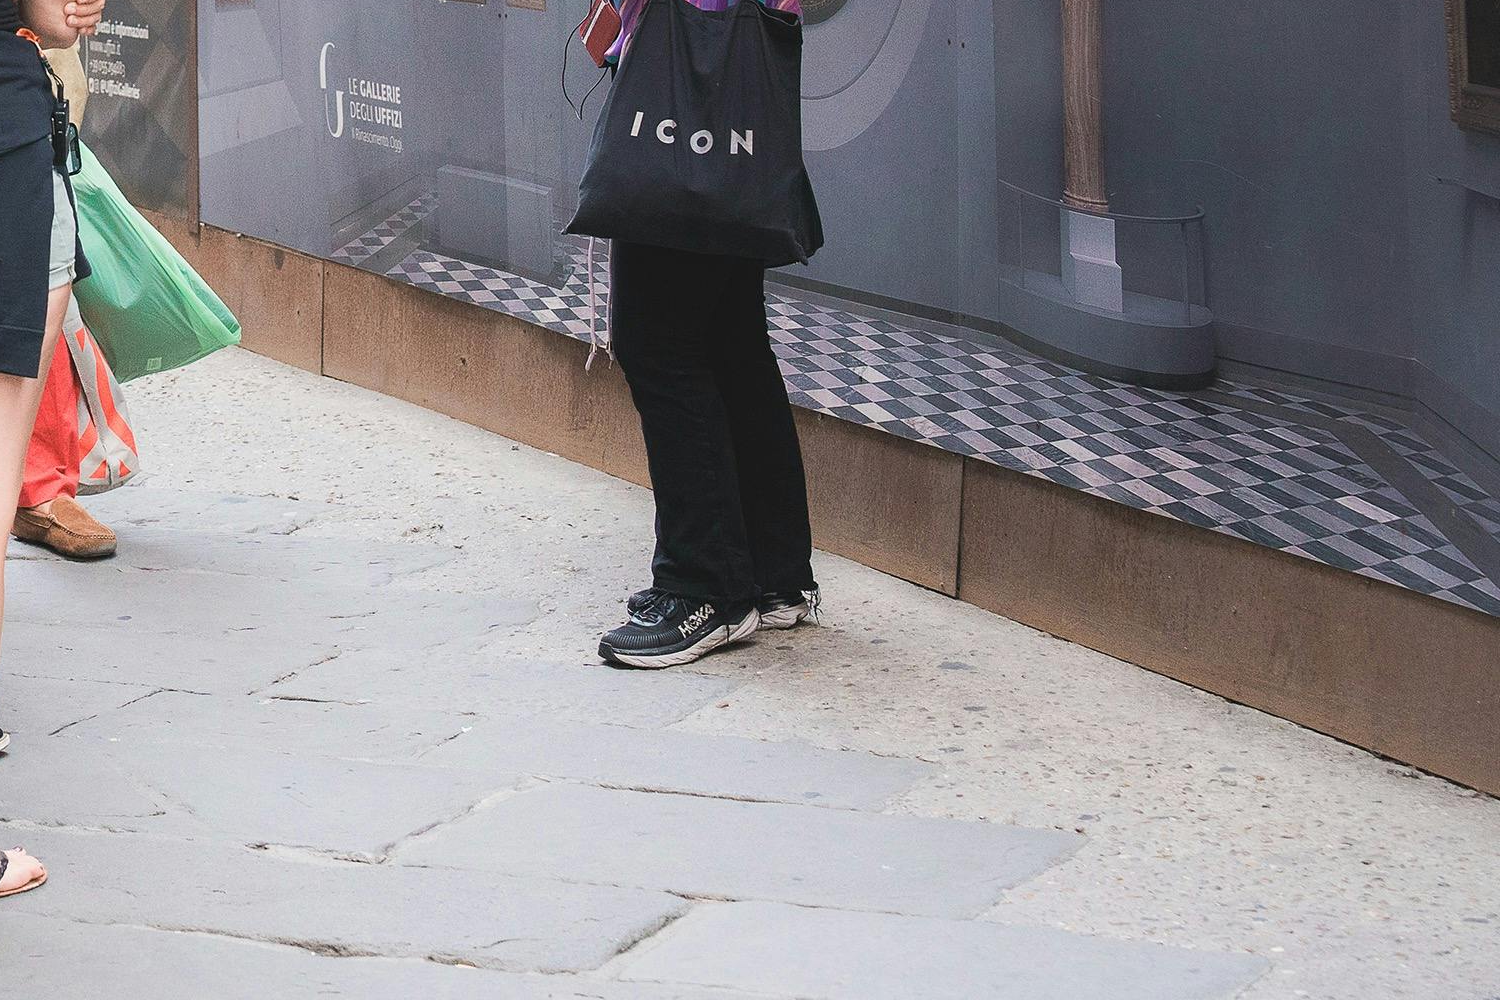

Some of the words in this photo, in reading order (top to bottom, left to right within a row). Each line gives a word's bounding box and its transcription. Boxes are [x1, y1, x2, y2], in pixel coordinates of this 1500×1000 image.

[348, 78, 359, 96] LE
[360, 80, 402, 104] GALLERIE
[350, 101, 374, 122] DEGLI
[375, 106, 403, 129] UFFIZI
[630, 111, 754, 156] ICON
